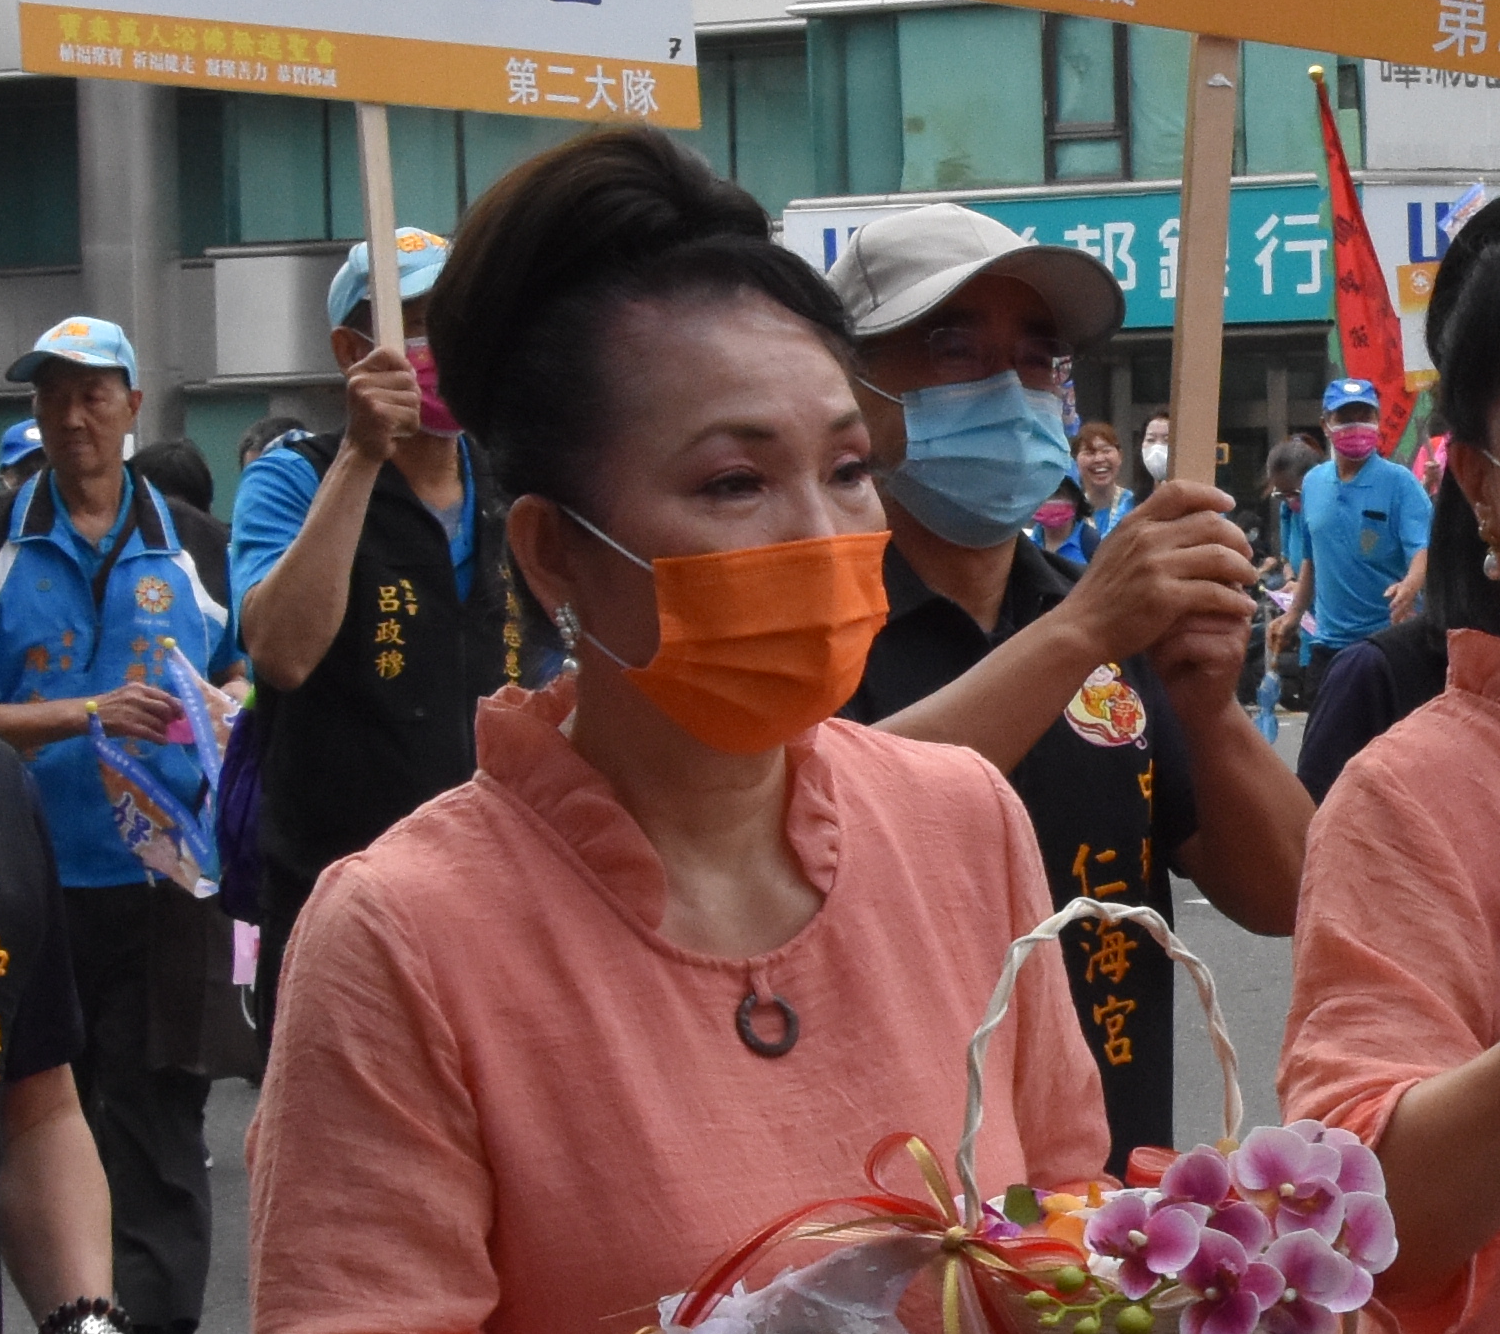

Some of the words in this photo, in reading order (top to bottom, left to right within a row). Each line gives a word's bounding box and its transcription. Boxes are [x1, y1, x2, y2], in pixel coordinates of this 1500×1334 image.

[668, 36, 682, 59] 7
[505, 56, 659, 117] 第二大隊
[1071, 842, 1140, 1066] 仁海宮
